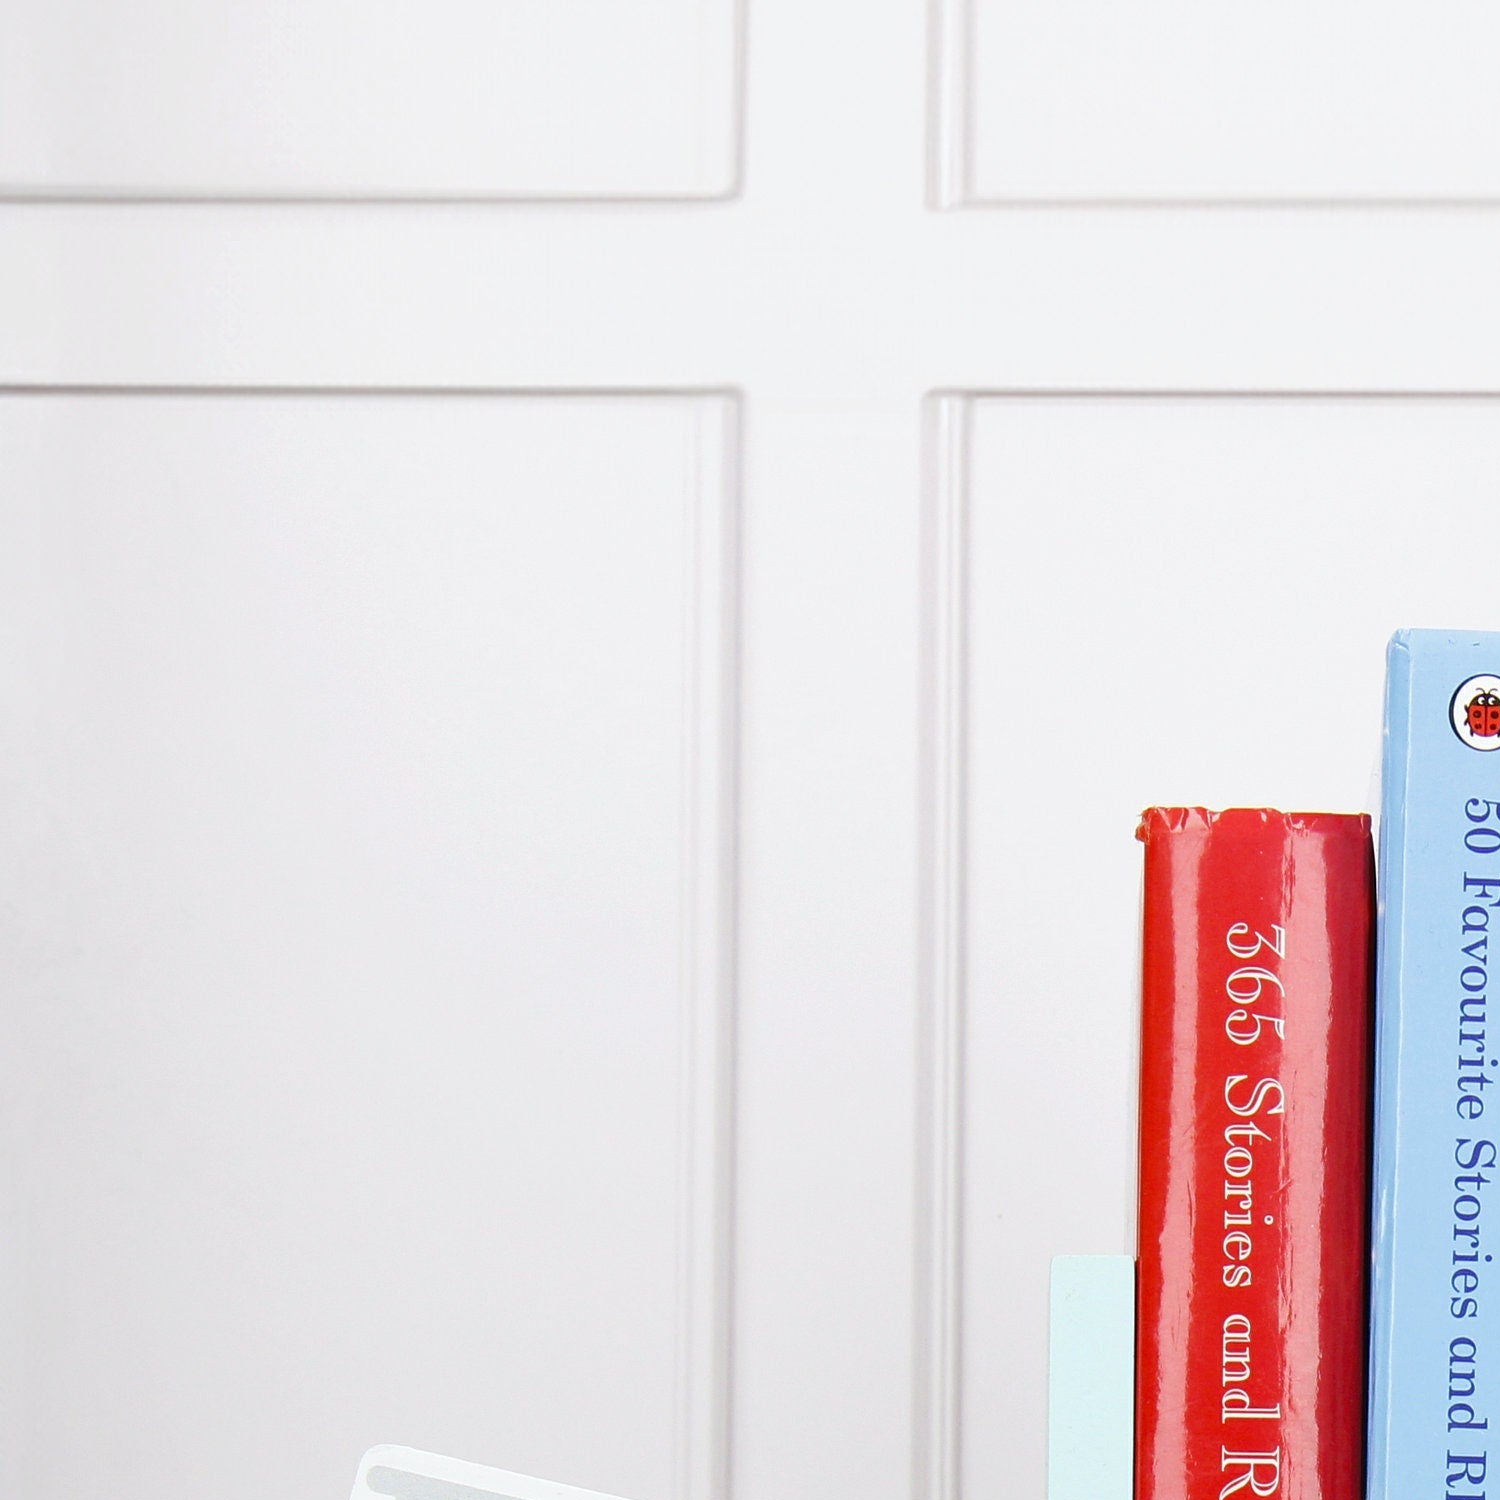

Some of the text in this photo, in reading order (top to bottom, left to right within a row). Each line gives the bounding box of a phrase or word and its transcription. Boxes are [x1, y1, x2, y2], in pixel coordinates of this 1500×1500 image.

[1224, 921, 1286, 1047] 365
[1221, 1073, 1286, 1289] Stories
[1450, 1137, 1498, 1320] Stories
[1221, 1313, 1281, 1425] and
[1446, 1336, 1489, 1435] and
